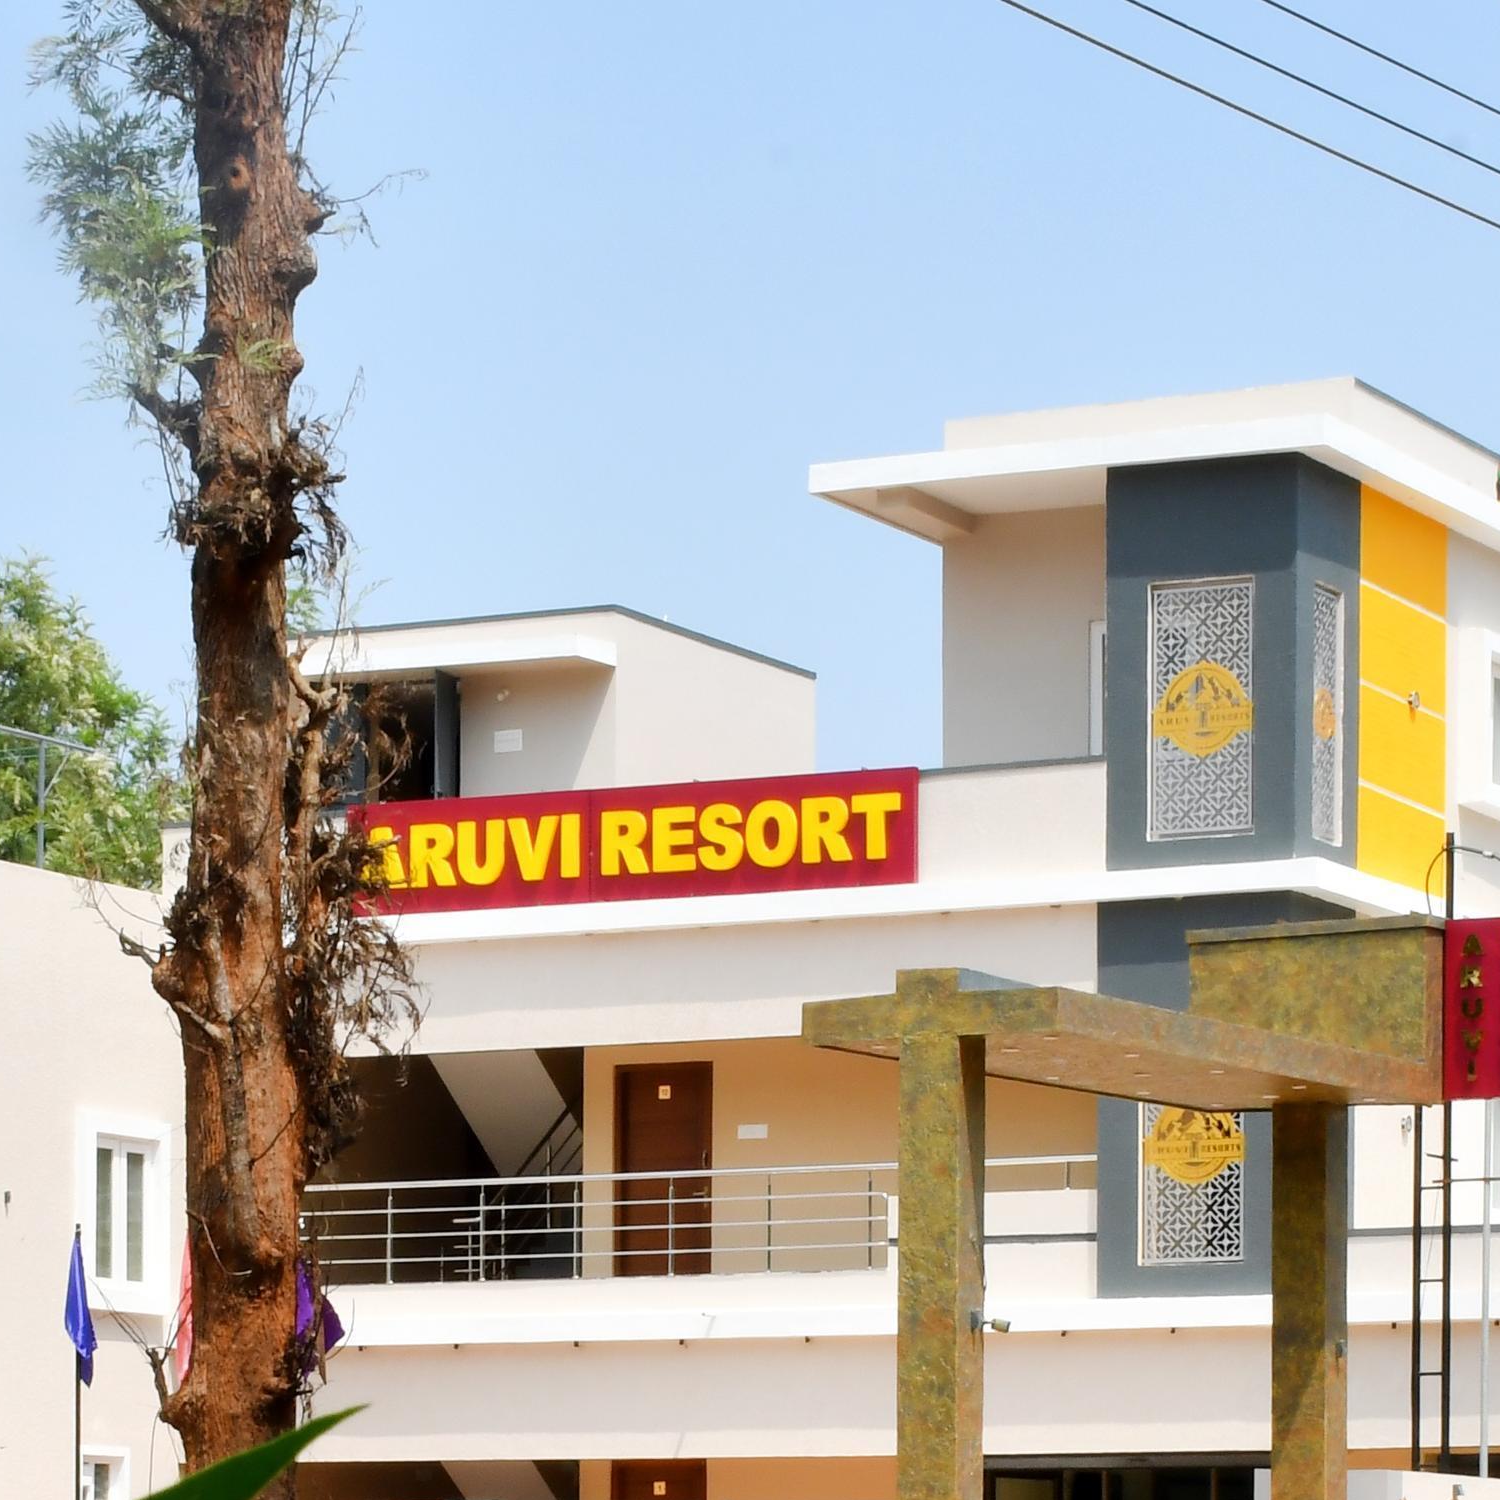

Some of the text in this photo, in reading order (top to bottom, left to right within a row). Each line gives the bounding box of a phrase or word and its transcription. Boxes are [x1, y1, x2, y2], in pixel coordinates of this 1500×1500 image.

[360, 791, 901, 889] ARUVI RESORT
[1460, 934, 1484, 1082] ARUVI
